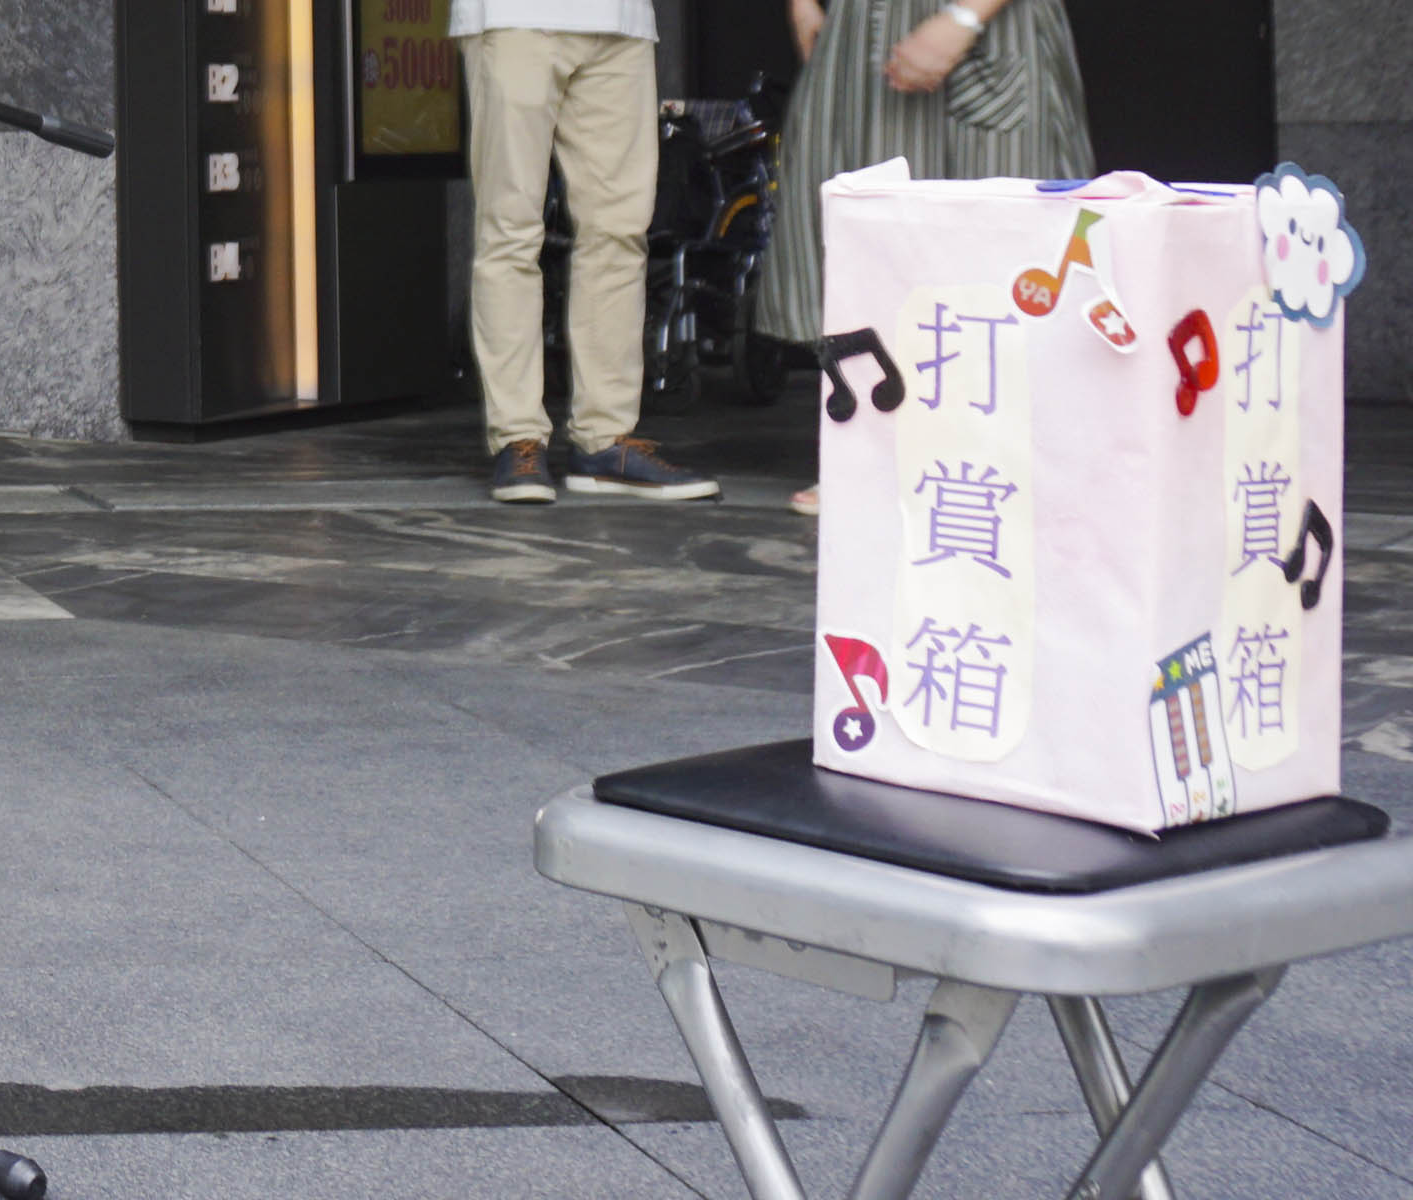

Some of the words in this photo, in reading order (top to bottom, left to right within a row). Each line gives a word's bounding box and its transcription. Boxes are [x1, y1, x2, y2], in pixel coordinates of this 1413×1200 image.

[208, 63, 240, 102] B2
[383, 35, 456, 91] 5000
[209, 152, 241, 192] B3
[1019, 276, 1051, 307] YA
[904, 302, 1019, 739] 打賞箱
[1227, 300, 1292, 740] 打賞箱
